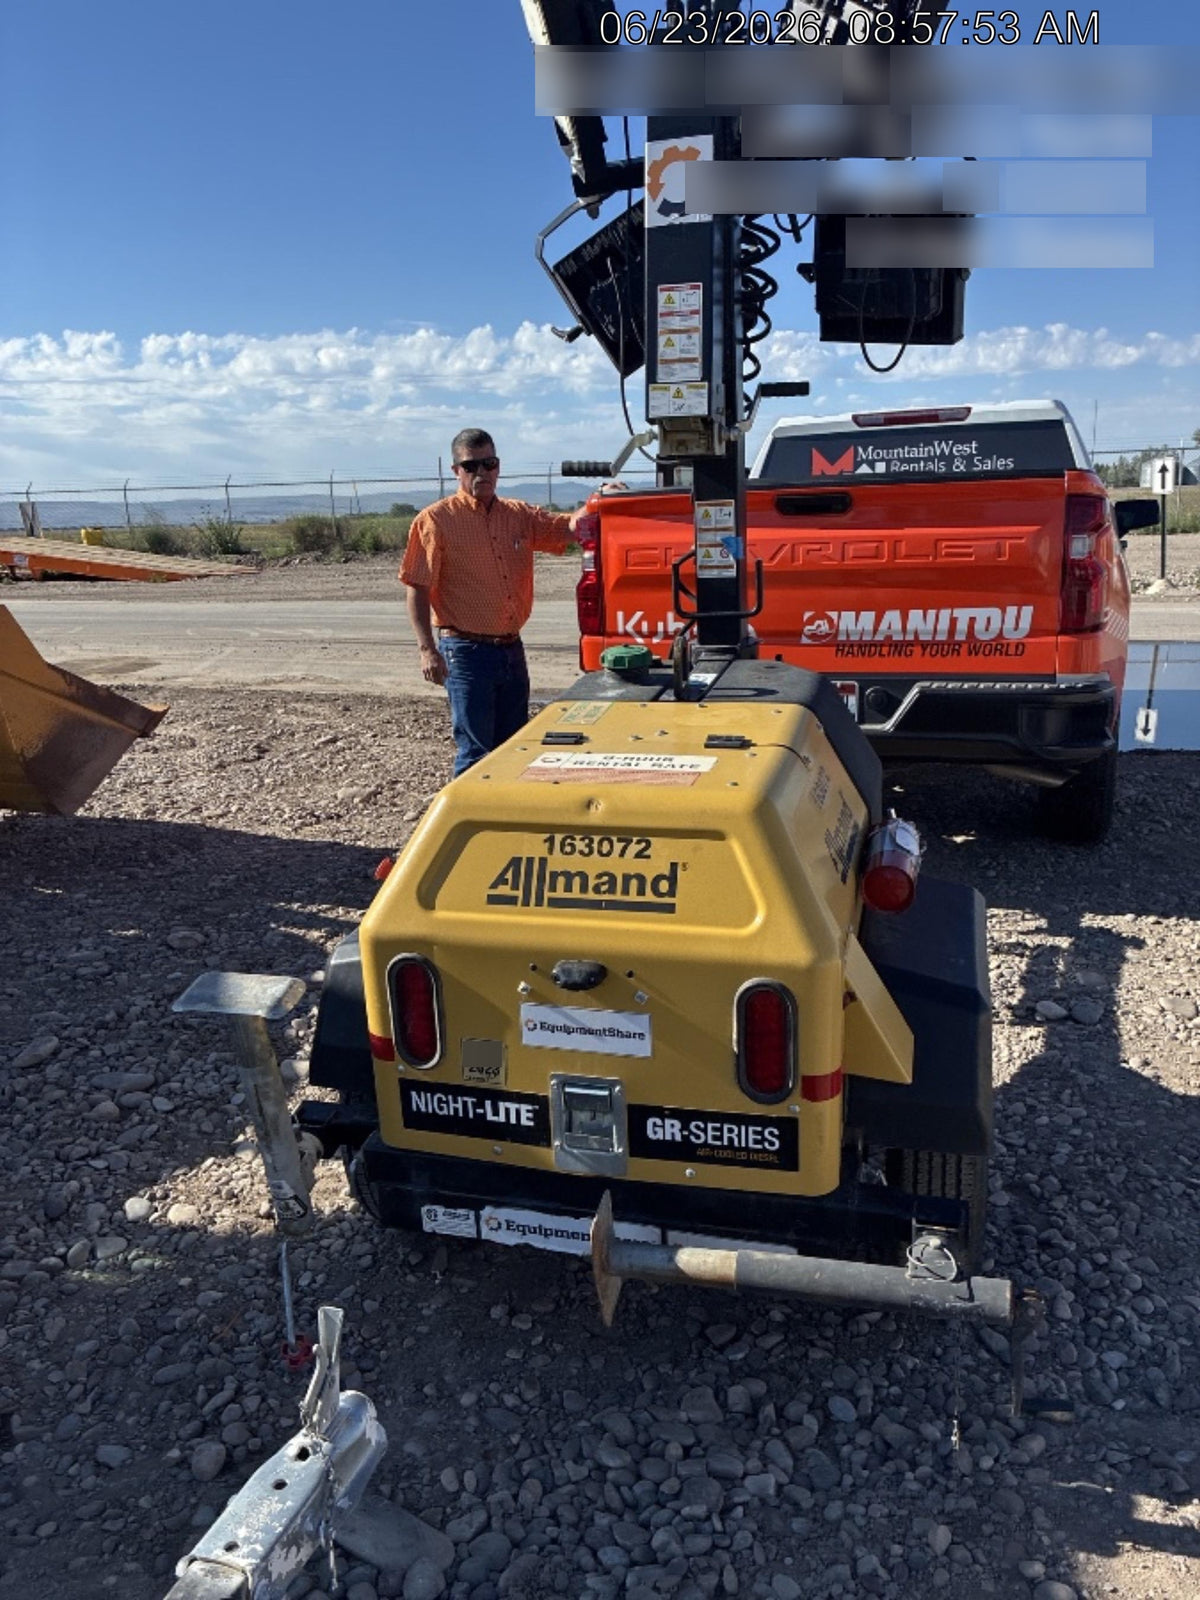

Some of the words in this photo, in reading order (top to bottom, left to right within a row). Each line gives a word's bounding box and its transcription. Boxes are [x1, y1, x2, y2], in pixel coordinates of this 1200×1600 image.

[856, 440, 979, 461] MountainWest
[890, 459, 946, 473] Rentals
[952, 457, 967, 472] &
[972, 455, 1015, 471] Sales
[626, 536, 1026, 570] CHVROLET
[837, 605, 1034, 641] MANITOU
[835, 642, 914, 658] HANDLING
[918, 642, 961, 658] YOUR
[967, 642, 1025, 657] WORLD
[543, 834, 652, 859] 163072
[487, 856, 679, 908] Allmand
[540, 1022, 646, 1040] EquipmentShare
[410, 1091, 535, 1127] NIGHT-LITE
[646, 1117, 780, 1151] GR-SERIES
